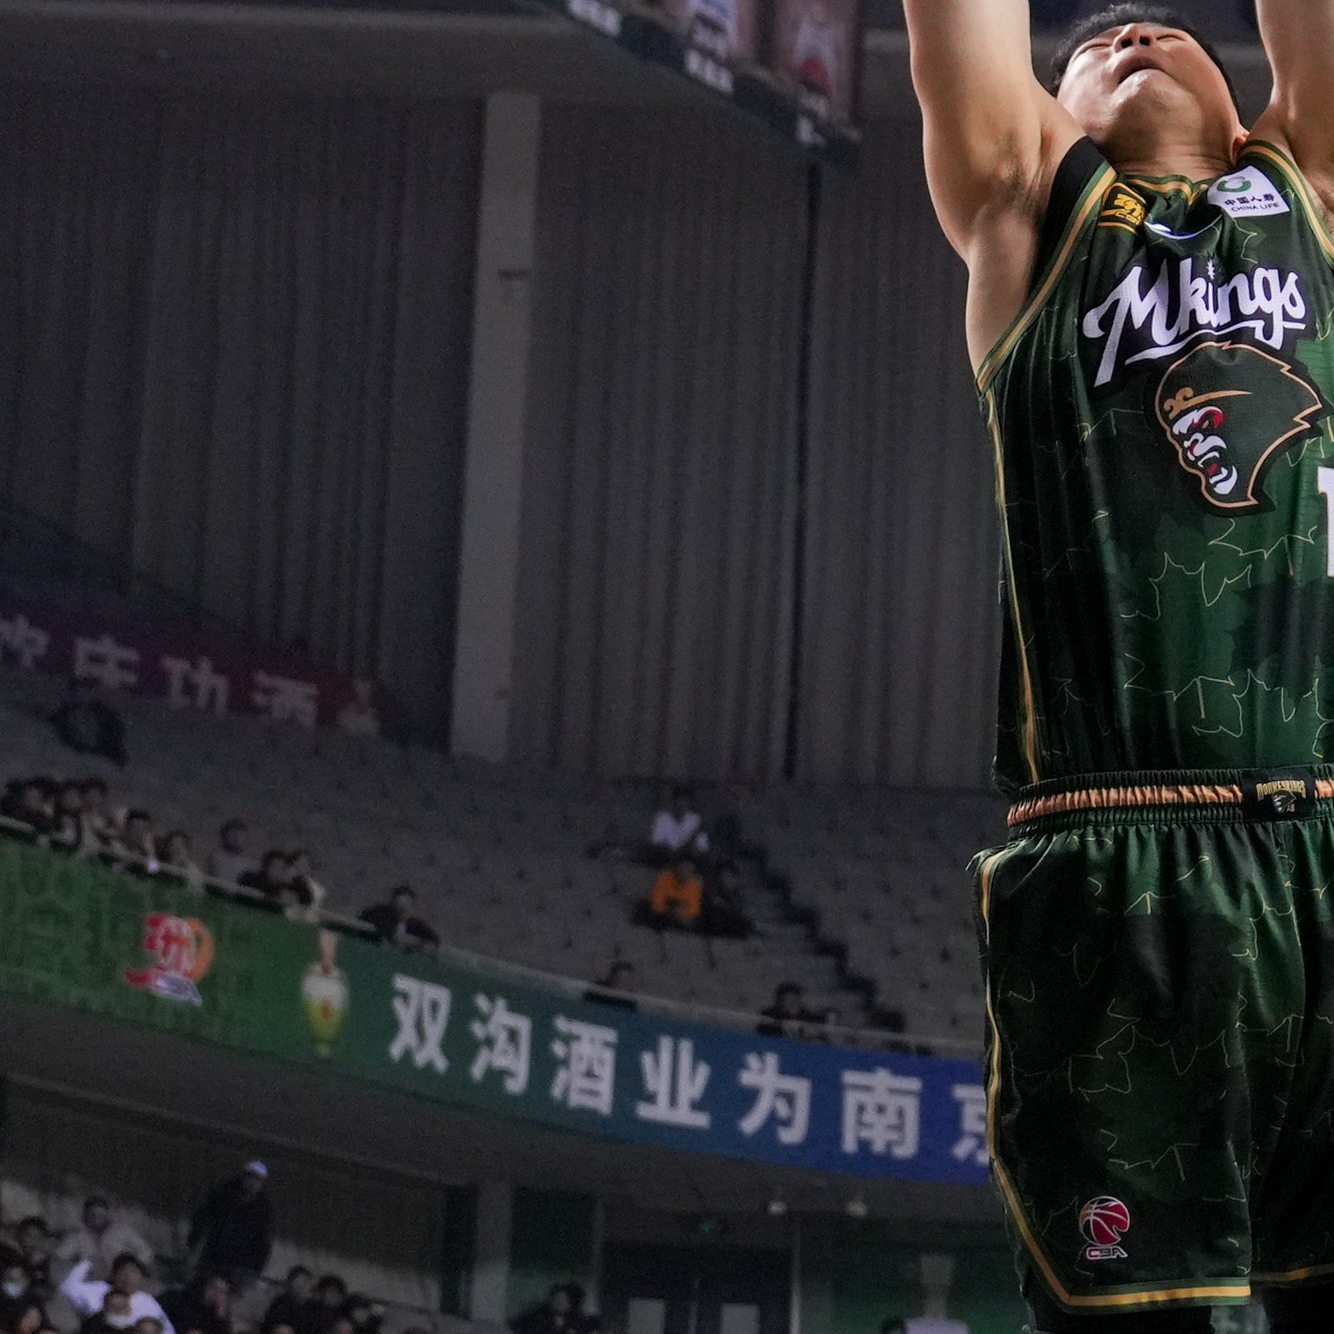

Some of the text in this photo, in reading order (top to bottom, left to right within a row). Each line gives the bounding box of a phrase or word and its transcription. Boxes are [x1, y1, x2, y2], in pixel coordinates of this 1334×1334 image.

[1231, 202, 1281, 213] CHINA LIFE
[1082, 258, 1307, 388] Mkings
[1085, 1245, 1128, 1259] CBA
